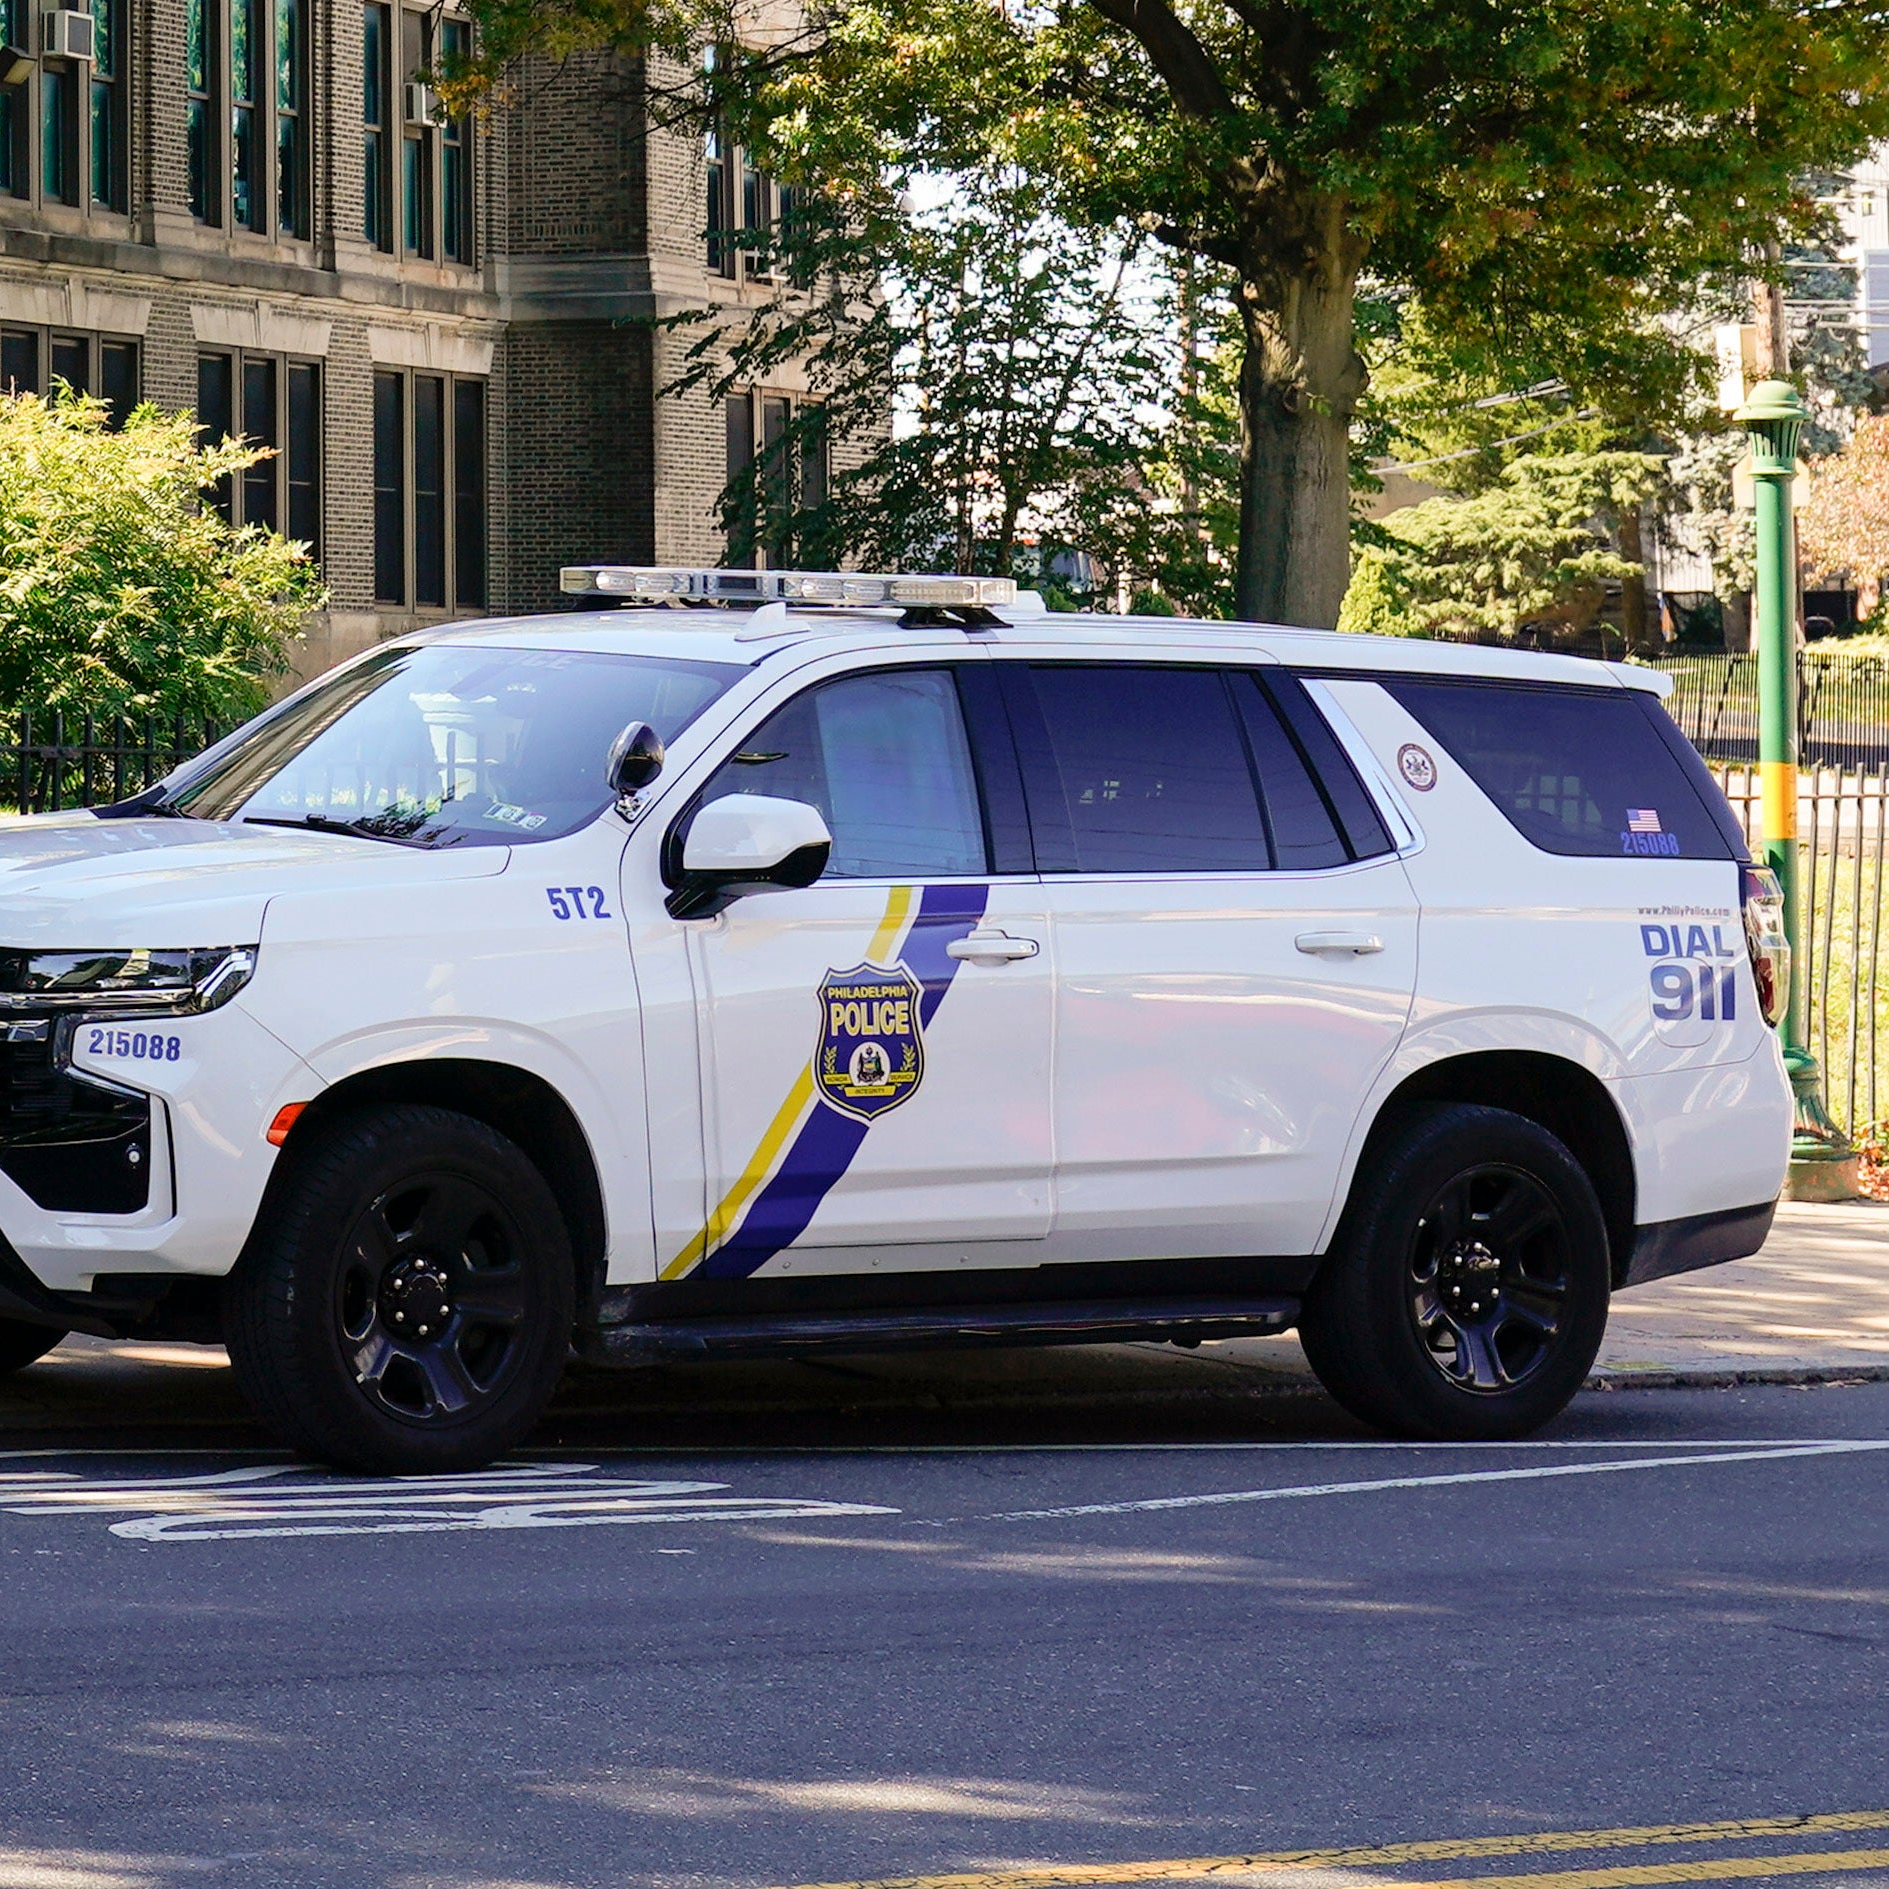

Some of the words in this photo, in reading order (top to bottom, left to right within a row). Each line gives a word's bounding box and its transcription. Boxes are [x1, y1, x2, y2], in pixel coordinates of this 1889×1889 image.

[1620, 832, 1680, 855] 215088
[545, 886, 612, 921] 5T2
[1639, 924, 1735, 958] DIAL
[827, 985, 908, 999] PHILADELPHIA
[1650, 964, 1736, 1021] 911
[830, 1000, 910, 1036] POLICE
[88, 1028, 181, 1062] 215088
